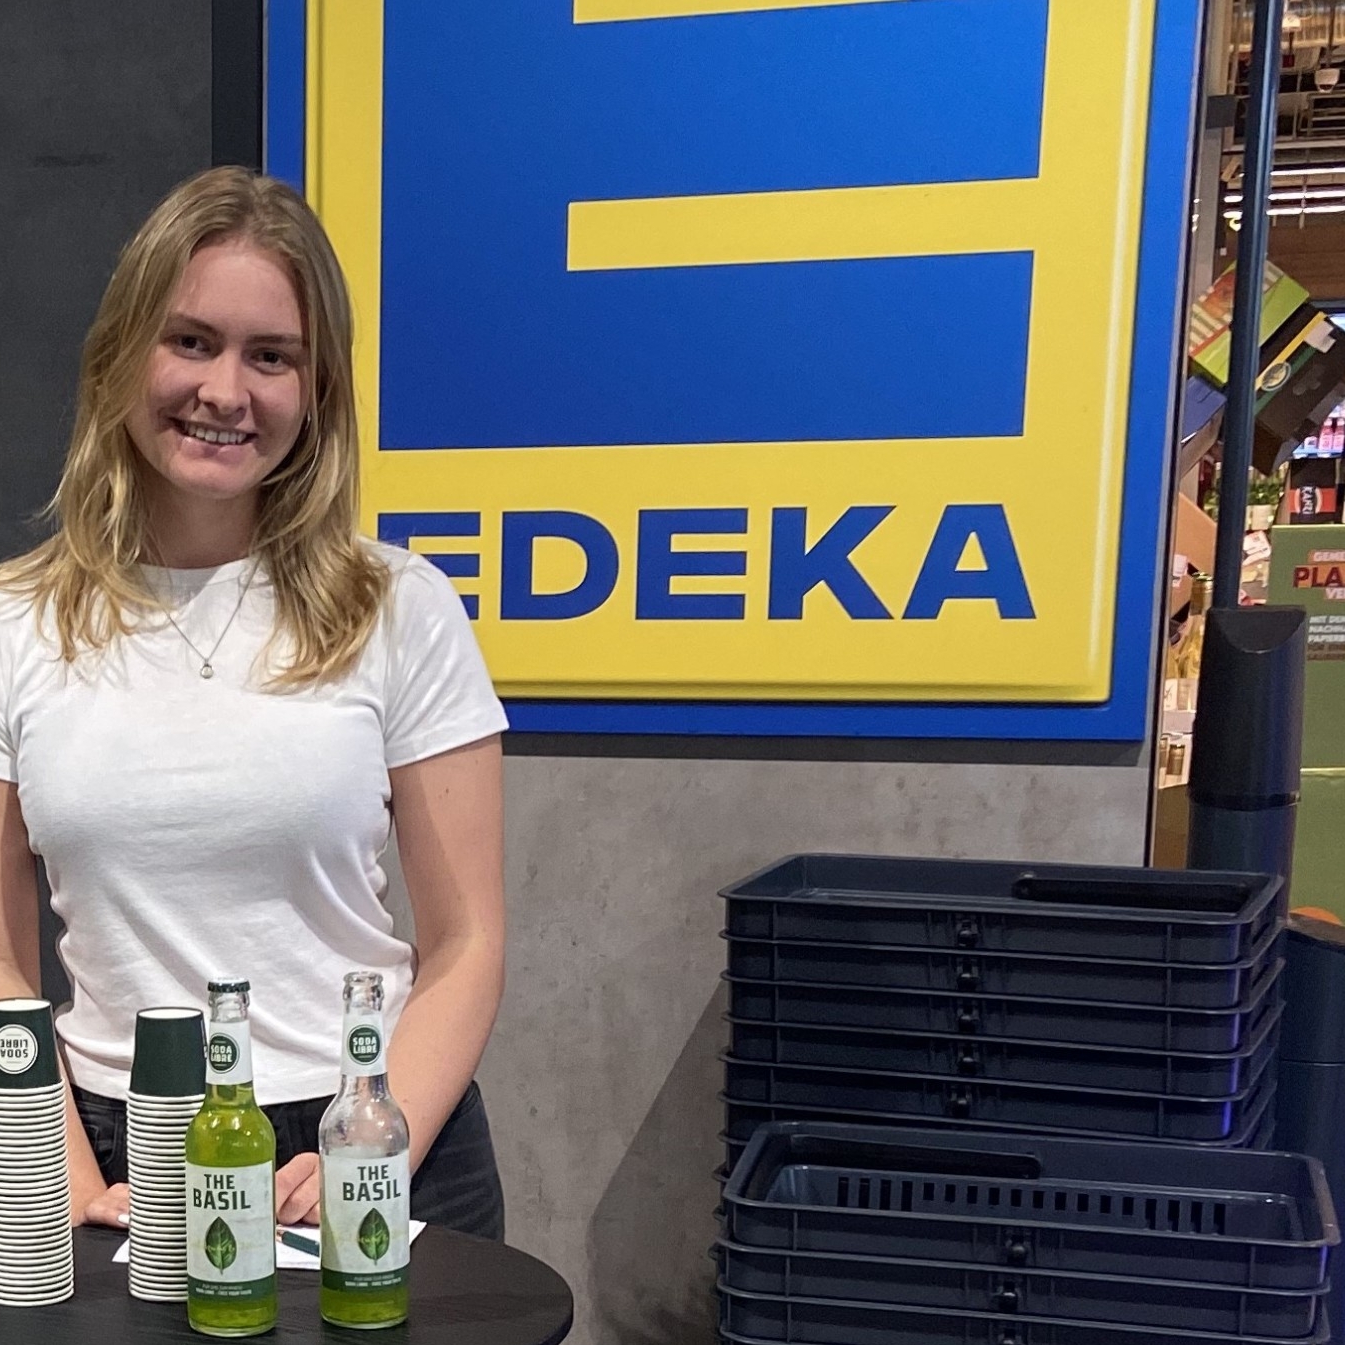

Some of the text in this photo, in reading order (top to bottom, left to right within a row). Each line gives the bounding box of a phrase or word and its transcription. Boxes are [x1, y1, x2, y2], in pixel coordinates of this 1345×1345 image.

[377, 503, 1037, 621] EDEKA
[0, 1038, 29, 1048] LIBRE
[352, 1036, 377, 1047] SODA
[0, 1048, 29, 1058] SODA
[210, 1044, 232, 1054] SODA
[353, 1044, 378, 1054] LIBRE
[210, 1053, 233, 1063] LIBRE
[357, 1164, 389, 1182] THE
[203, 1173, 235, 1191] THE
[342, 1181, 401, 1203] BASIL
[192, 1188, 252, 1211] BASIL
